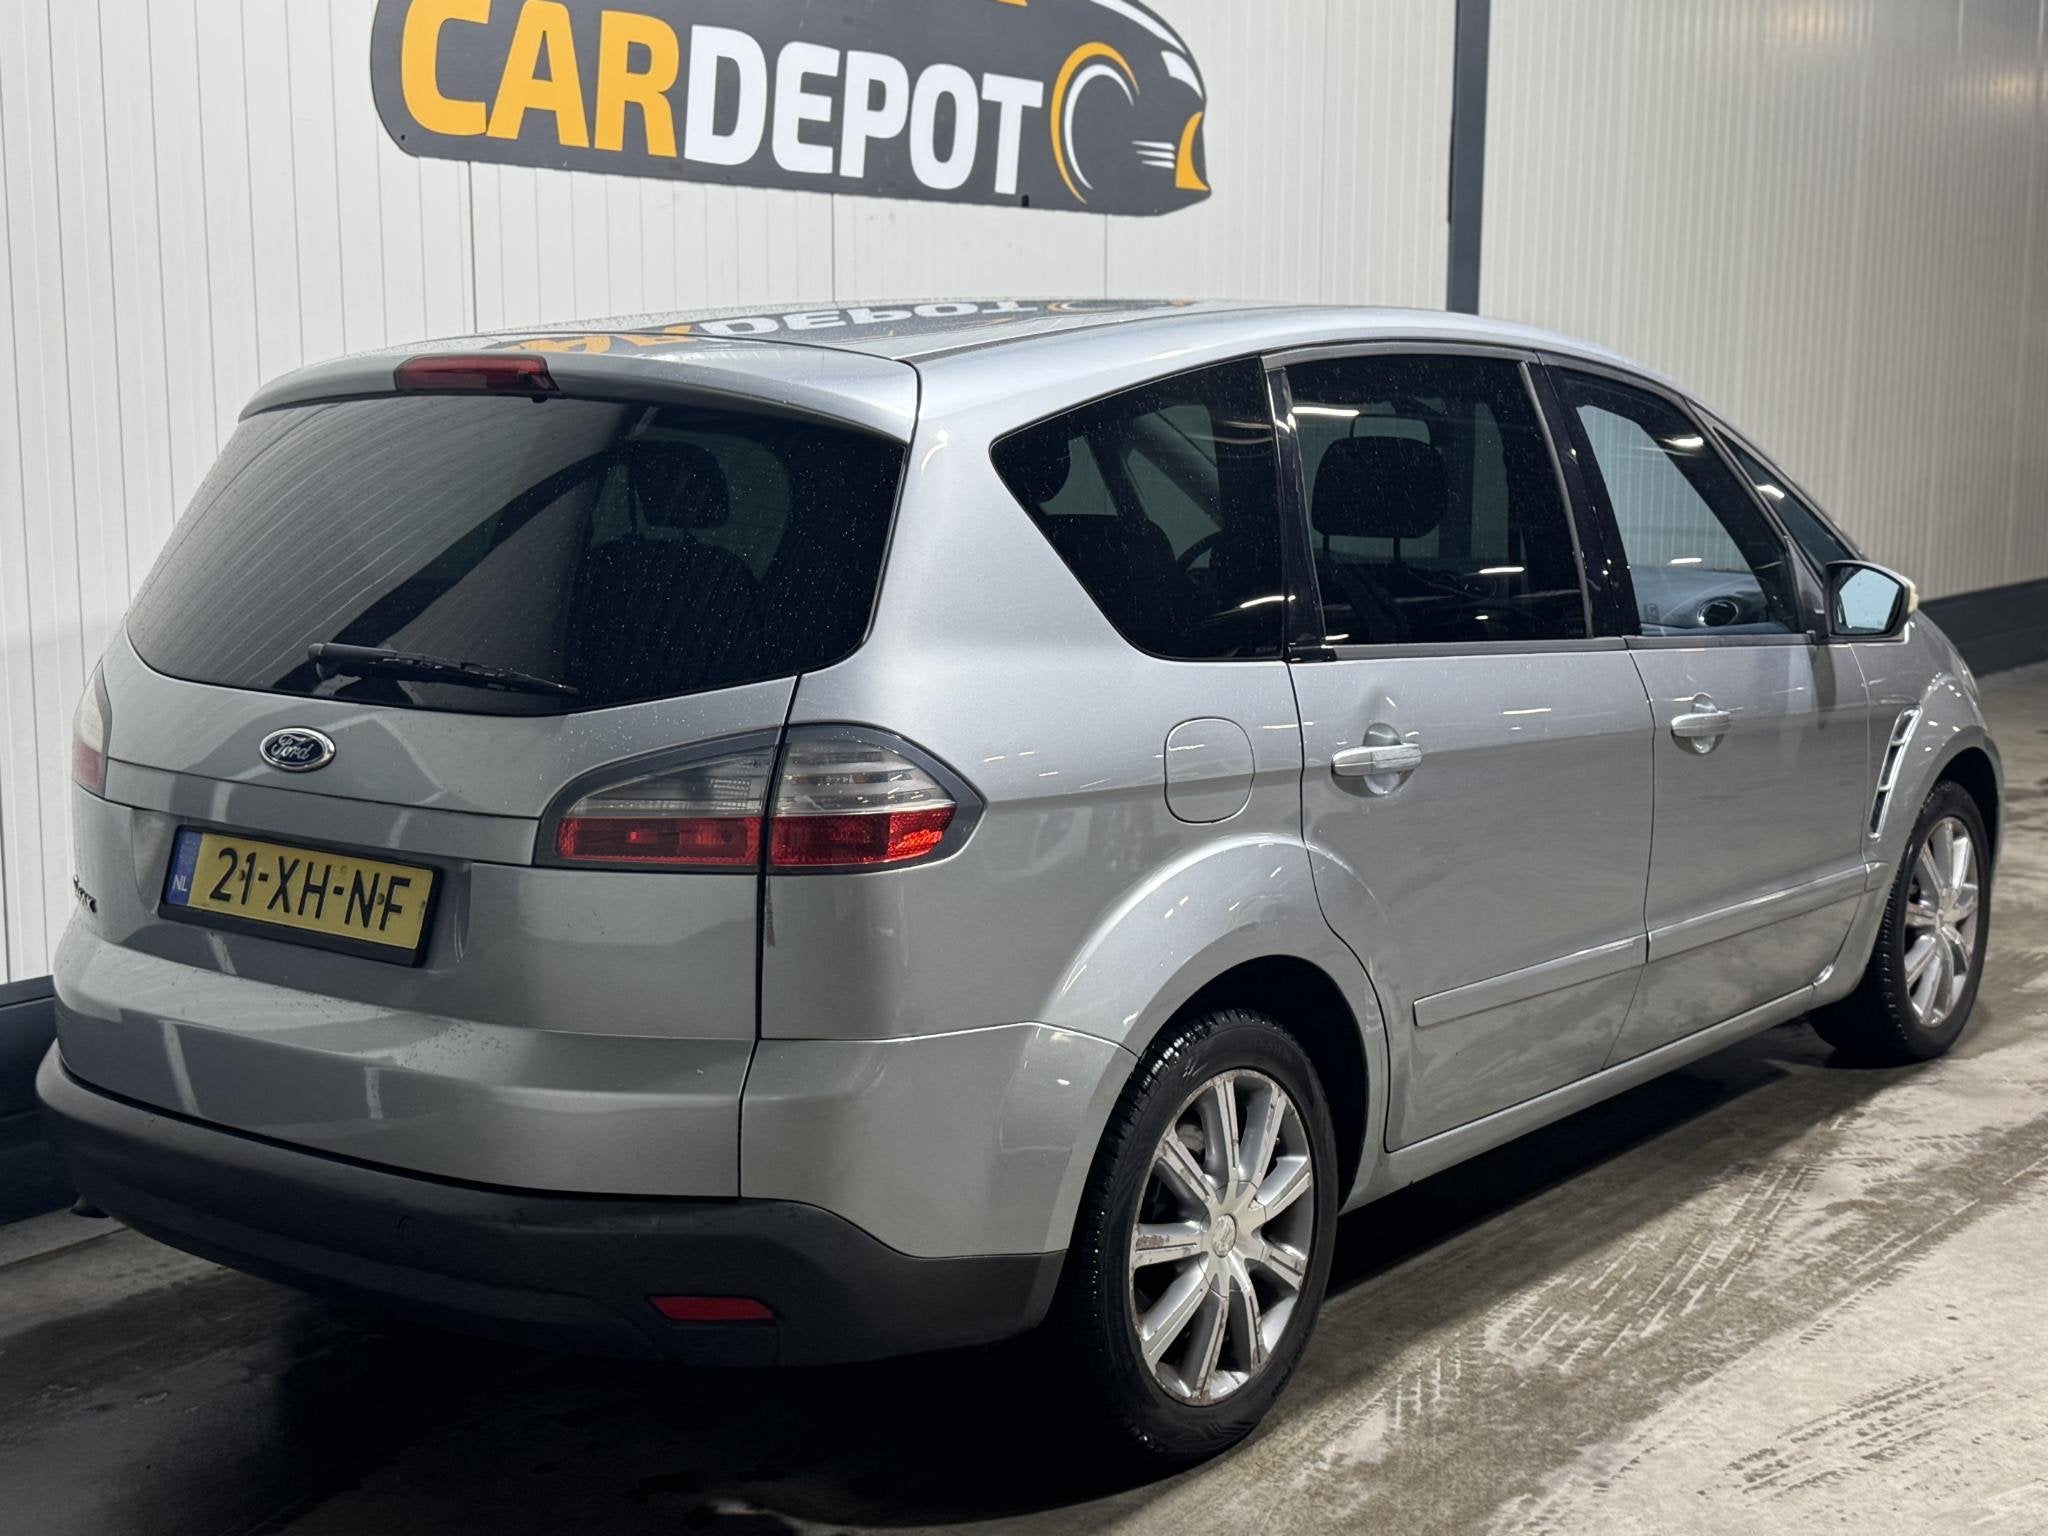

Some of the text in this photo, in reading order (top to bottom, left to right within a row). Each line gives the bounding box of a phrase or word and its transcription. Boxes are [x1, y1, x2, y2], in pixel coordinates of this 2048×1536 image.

[271, 734, 315, 760] Ford
[172, 874, 189, 893] NL
[208, 847, 412, 932] 21-XH-NF
